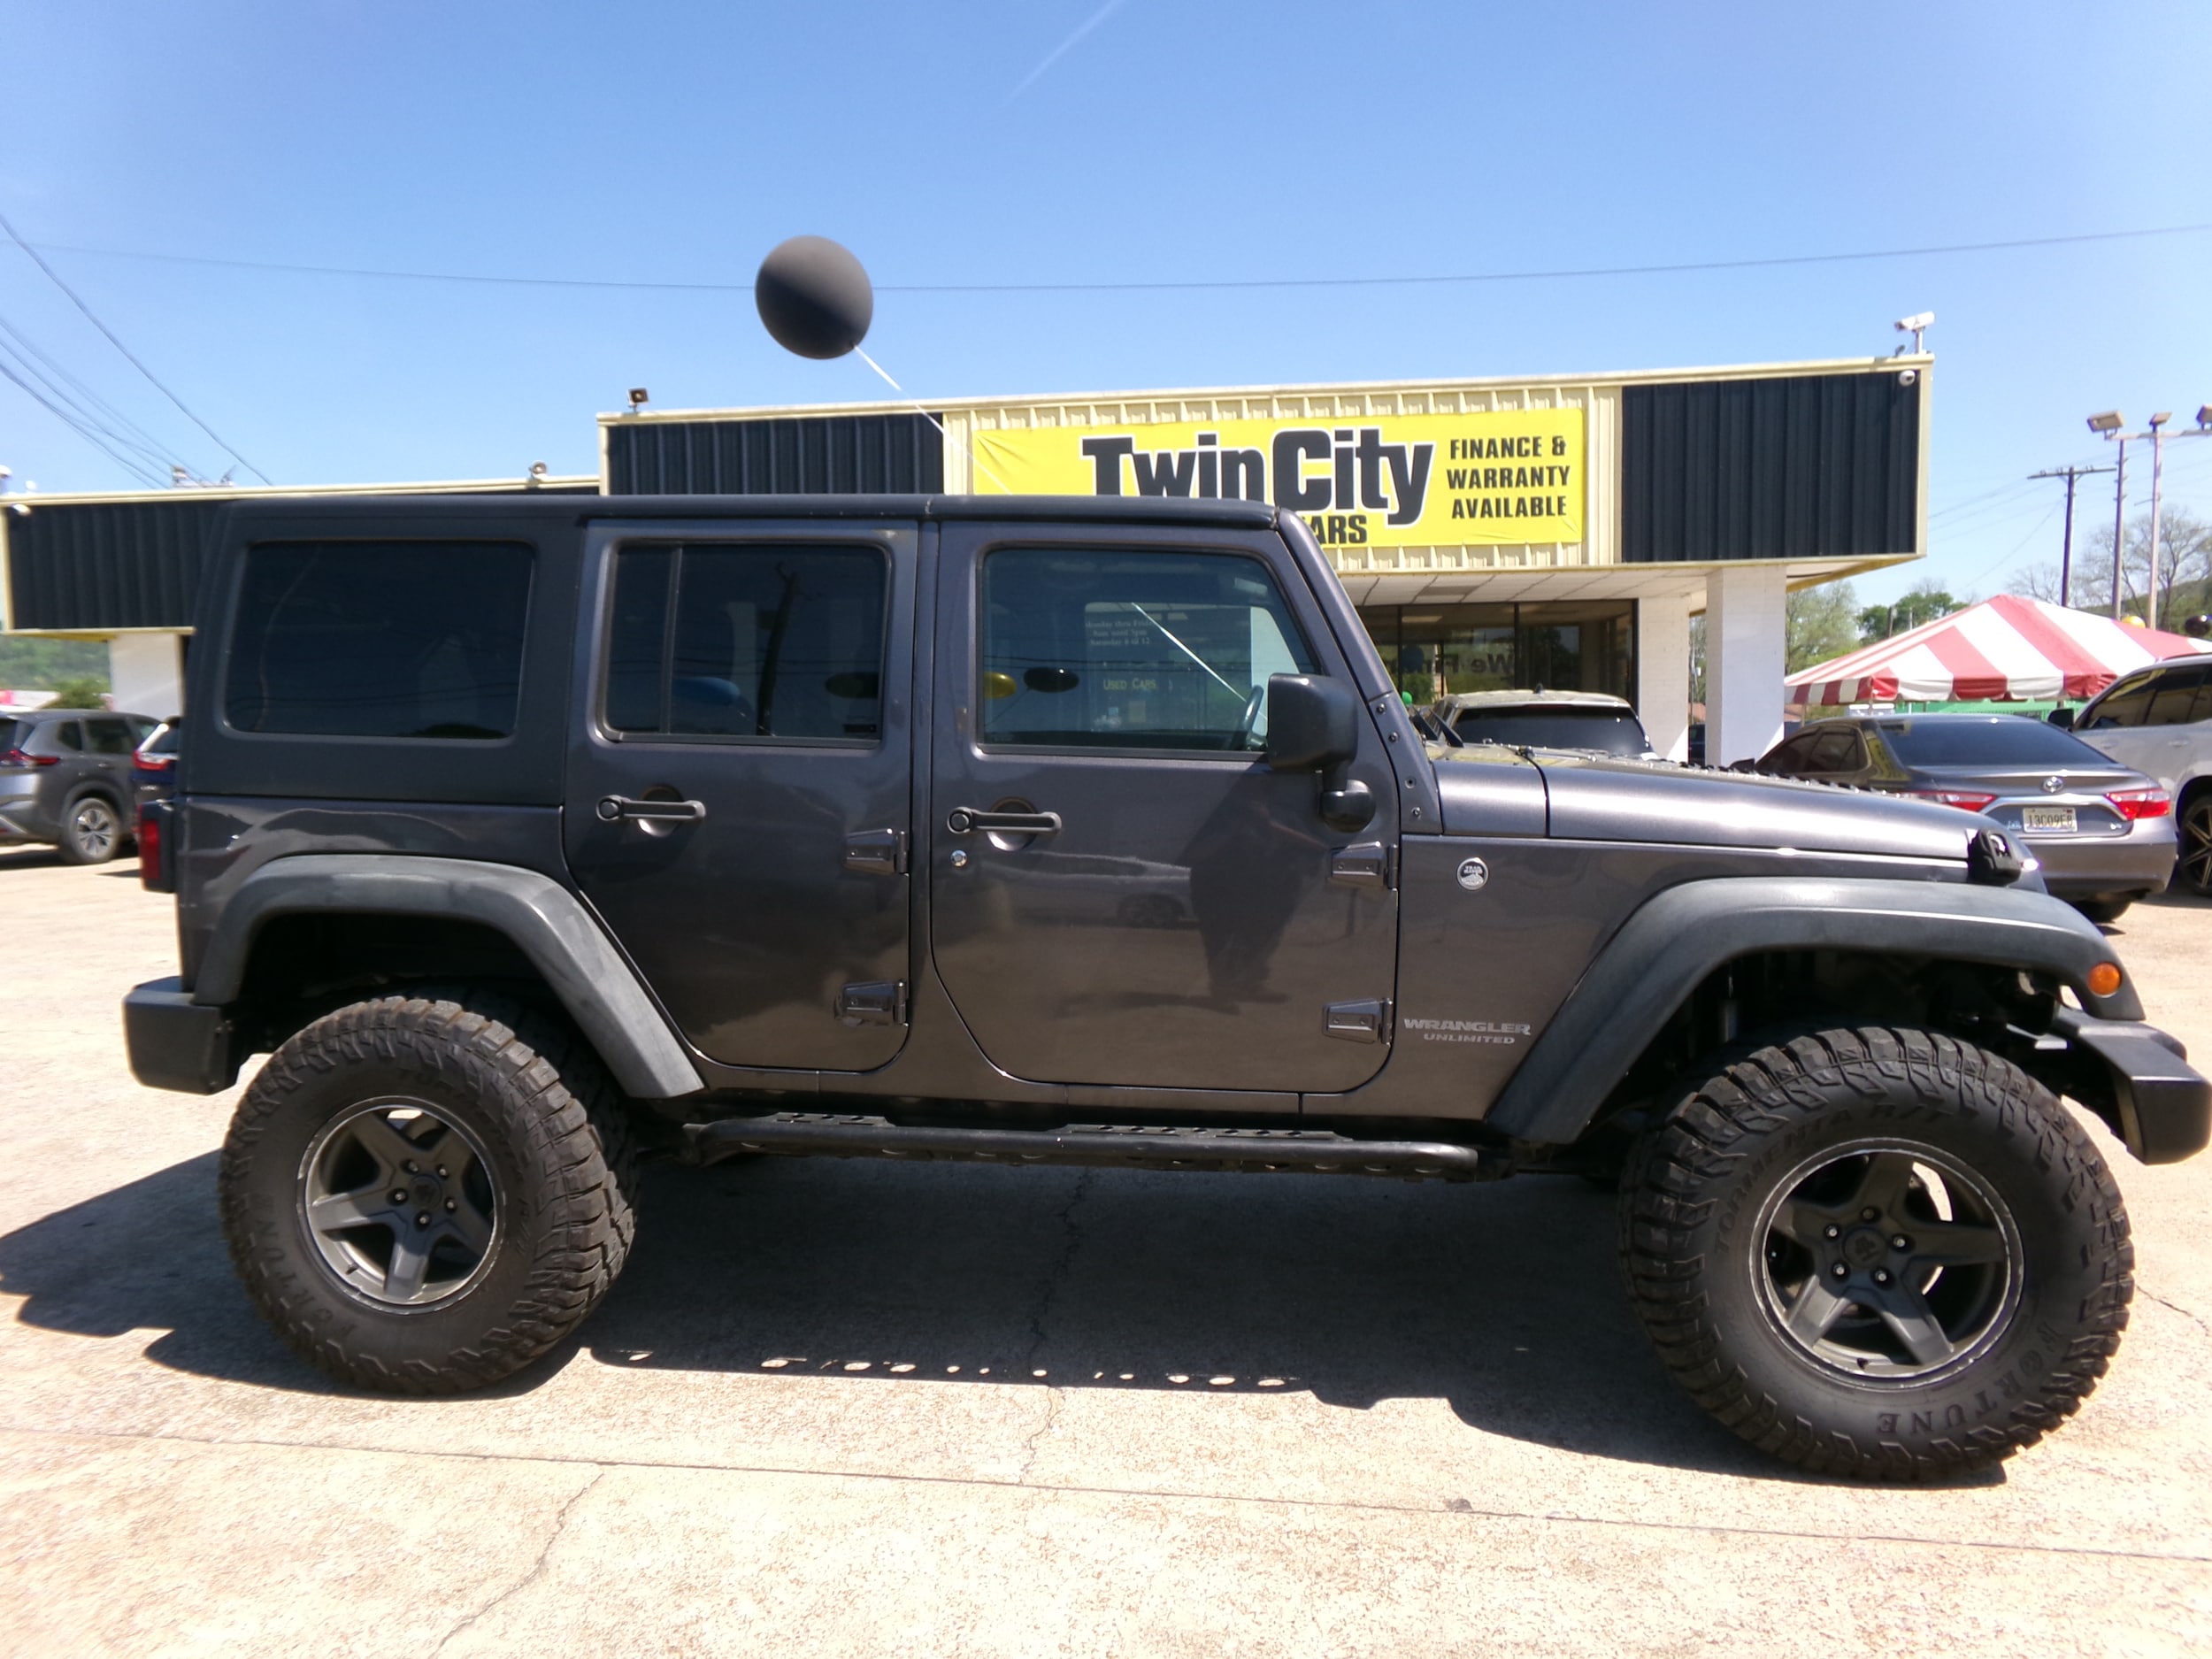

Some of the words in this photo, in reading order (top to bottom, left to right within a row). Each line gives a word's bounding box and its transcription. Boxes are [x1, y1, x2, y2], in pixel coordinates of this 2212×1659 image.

[1450, 436, 1542, 460] FINANCE
[1551, 435, 1567, 457] &
[1447, 465, 1571, 489] WARRANTY
[1451, 495, 1567, 519] AVAILABLE
[1302, 515, 1367, 544] ARS
[1404, 1018, 1531, 1035] WRANGLER
[1424, 1033, 1515, 1044] UNLIMITED
